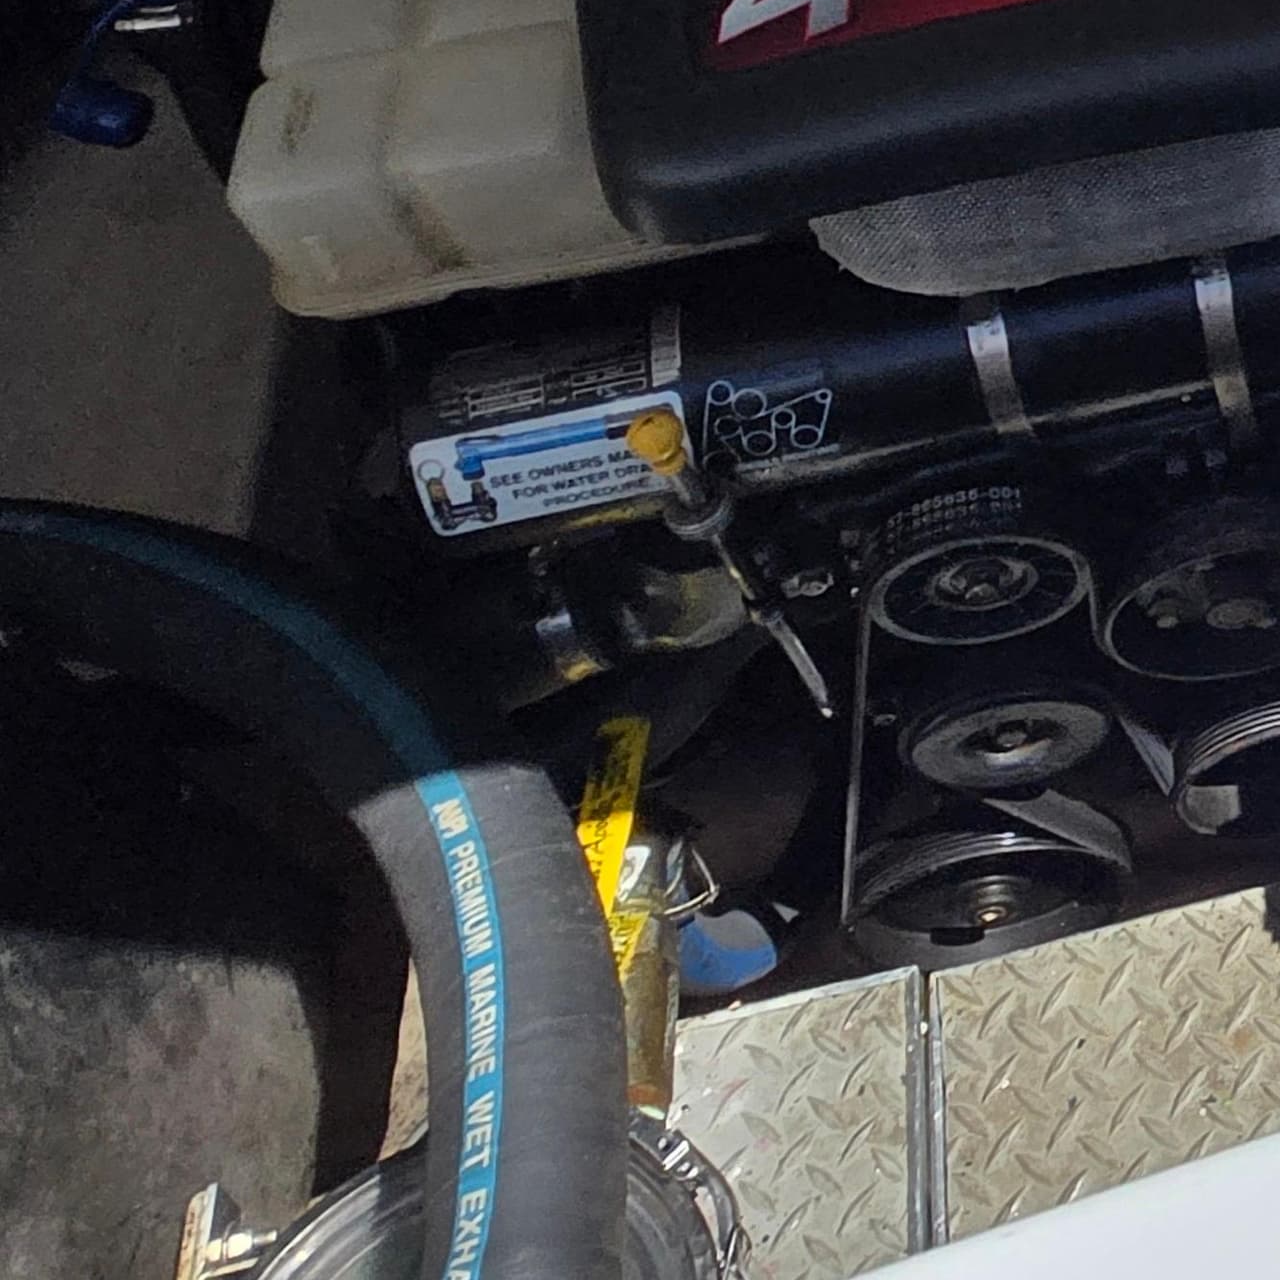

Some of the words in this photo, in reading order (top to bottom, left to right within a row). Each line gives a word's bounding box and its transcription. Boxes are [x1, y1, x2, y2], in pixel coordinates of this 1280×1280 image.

[490, 473, 521, 488] SEE
[528, 456, 602, 478] OWNERS
[512, 484, 547, 499] FOR
[552, 471, 609, 490] WATER
[614, 463, 652, 477] DRA
[448, 839, 493, 956] PREMIUM
[467, 963, 497, 1084] MARINE
[463, 1091, 496, 1169] WET
